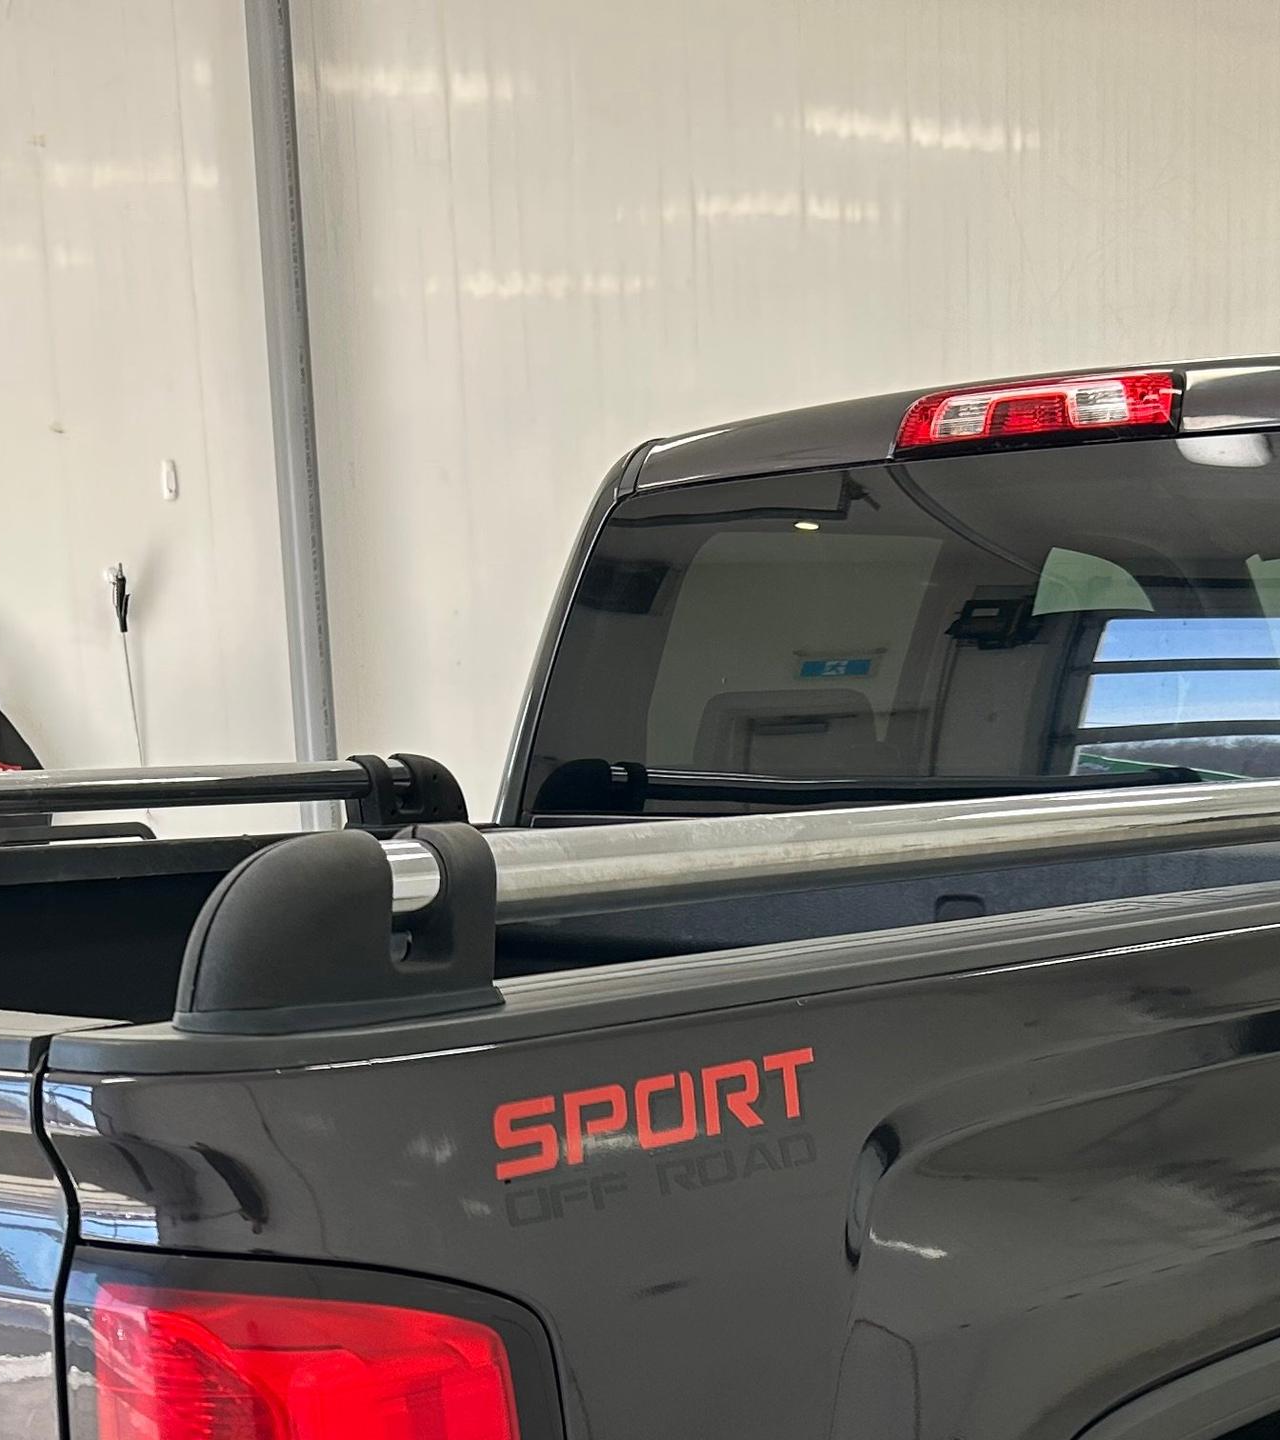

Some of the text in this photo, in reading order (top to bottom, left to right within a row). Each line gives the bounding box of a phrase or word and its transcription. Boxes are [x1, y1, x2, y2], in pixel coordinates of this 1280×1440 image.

[493, 1047, 815, 1182] SPORT
[504, 1132, 817, 1228] OFF ROAD
